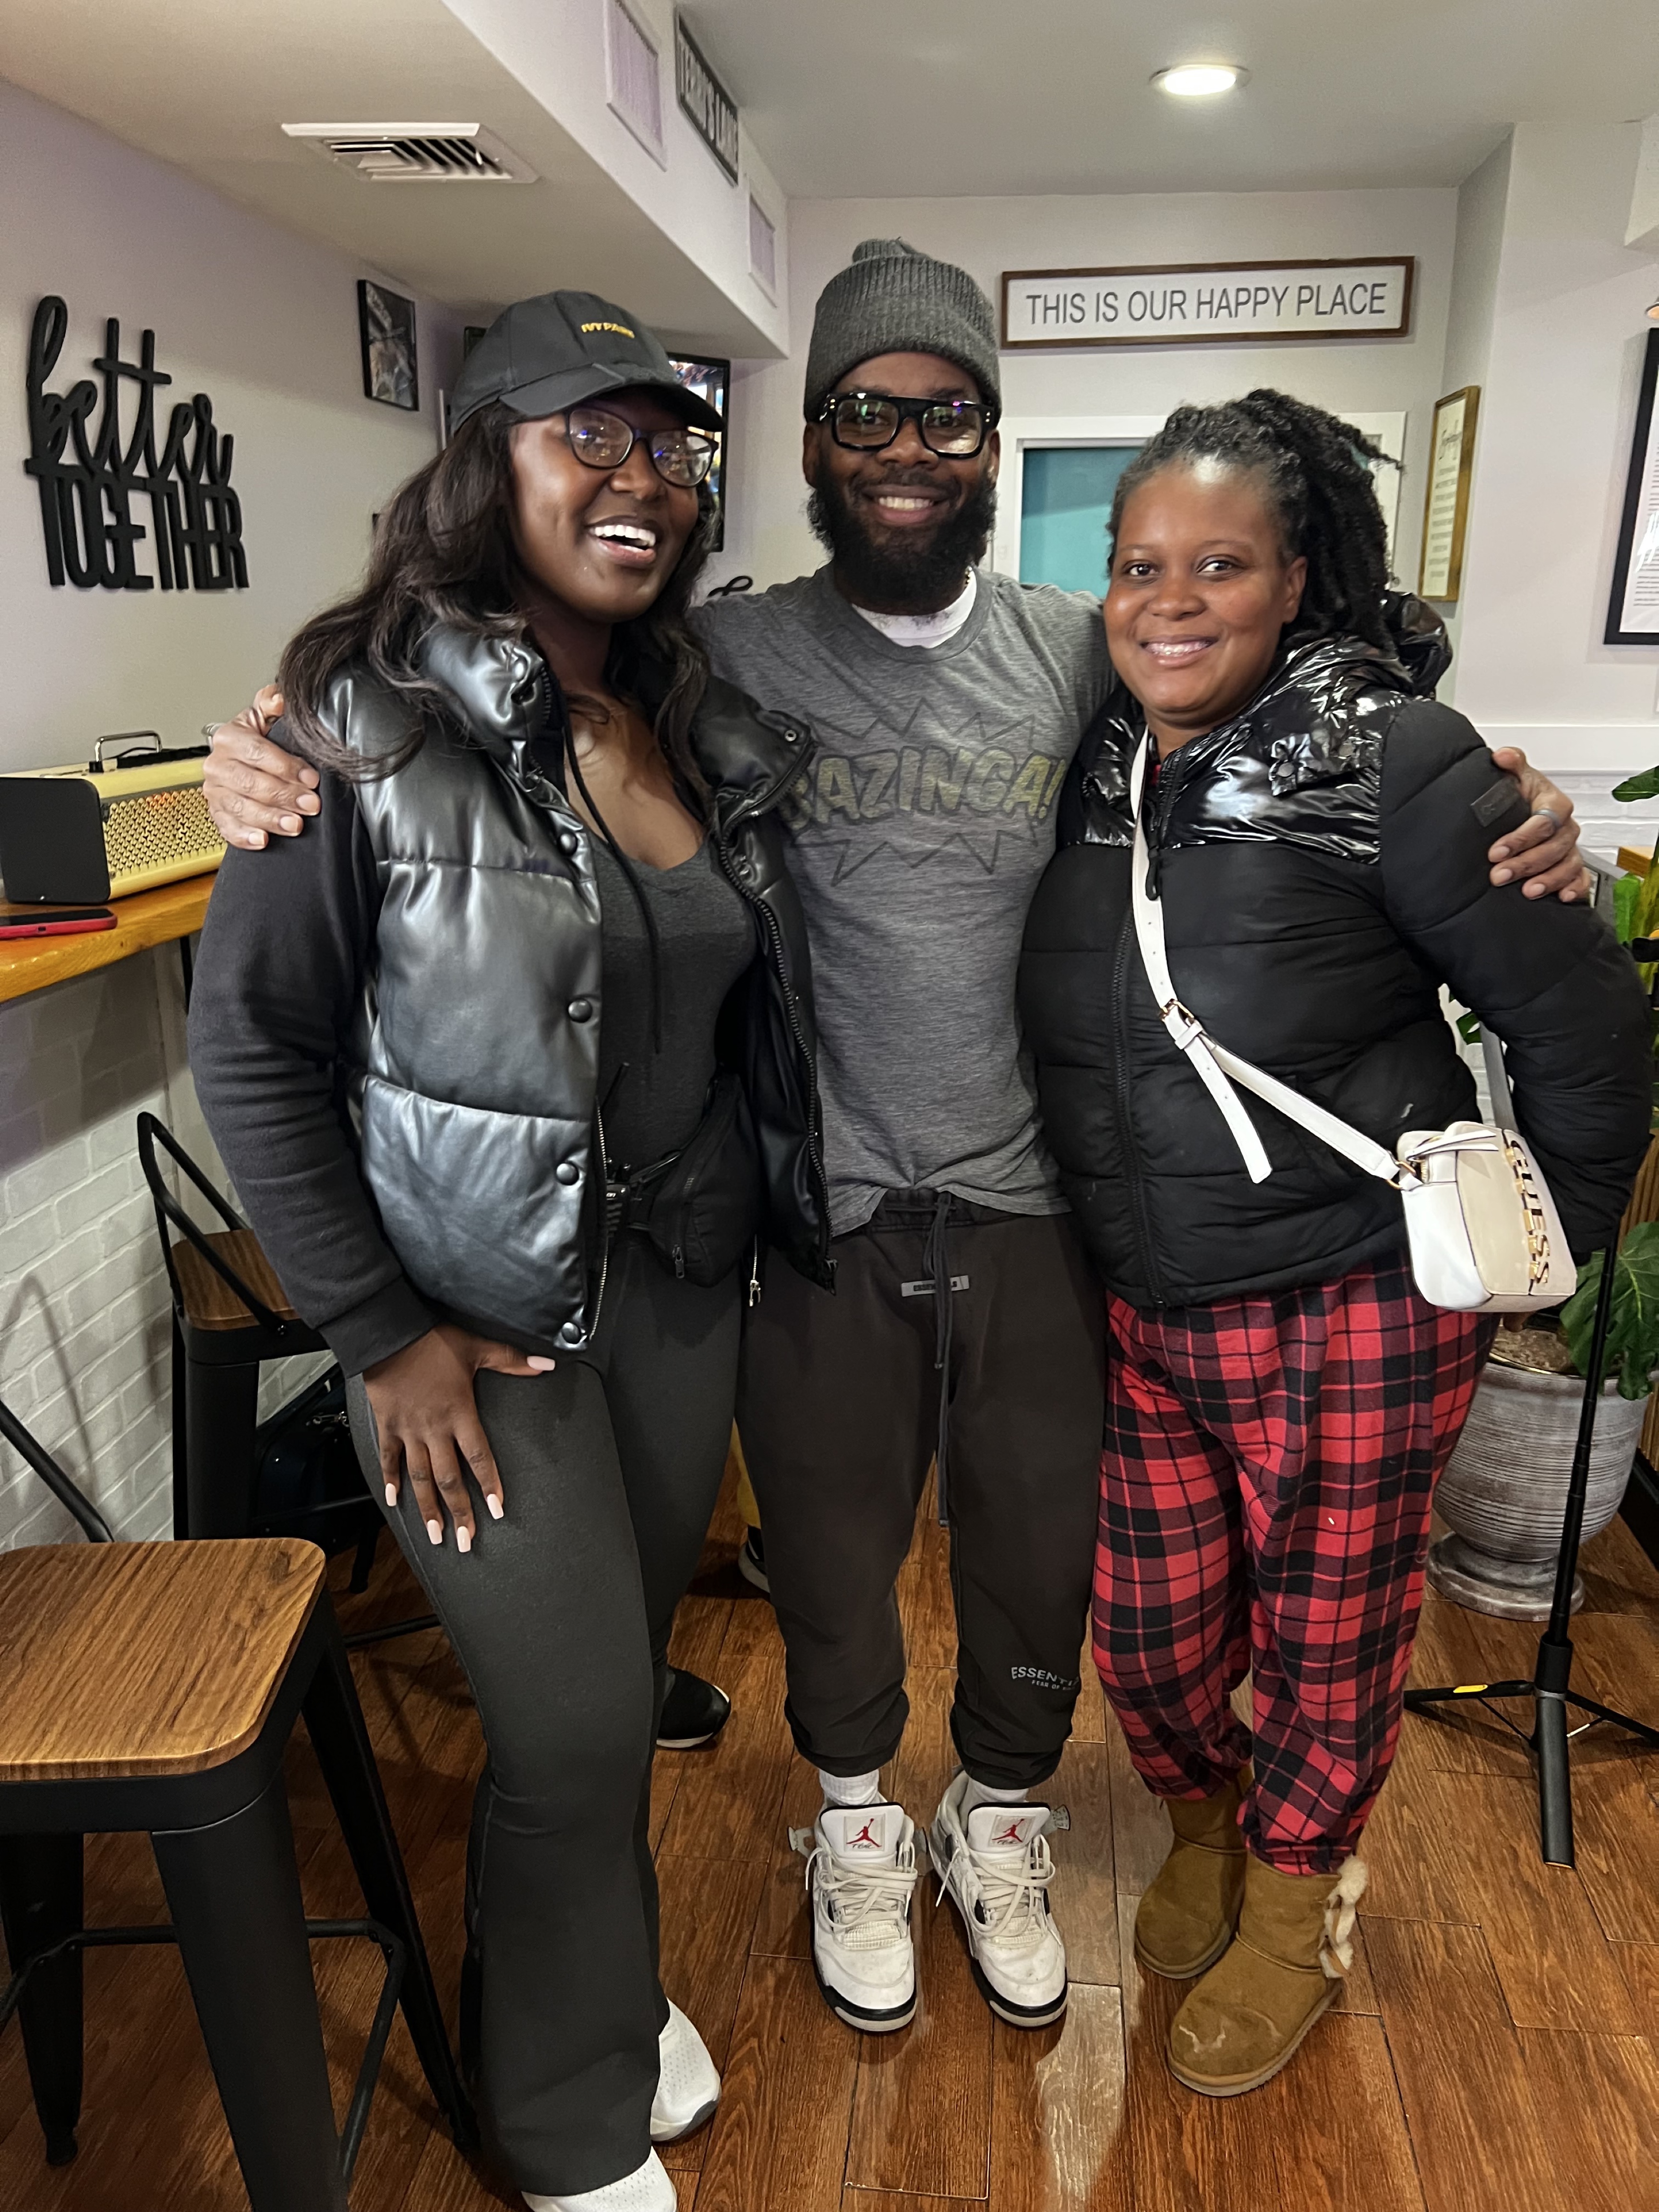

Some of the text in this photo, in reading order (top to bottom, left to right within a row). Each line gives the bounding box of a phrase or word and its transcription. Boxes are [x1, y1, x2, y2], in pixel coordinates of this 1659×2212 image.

[1025, 282, 1388, 325] THIS IS OUR HAPPY PLACE
[26, 295, 234, 483] better
[24, 457, 250, 591] TOGETHER
[1505, 1140, 1551, 1284] GUESS
